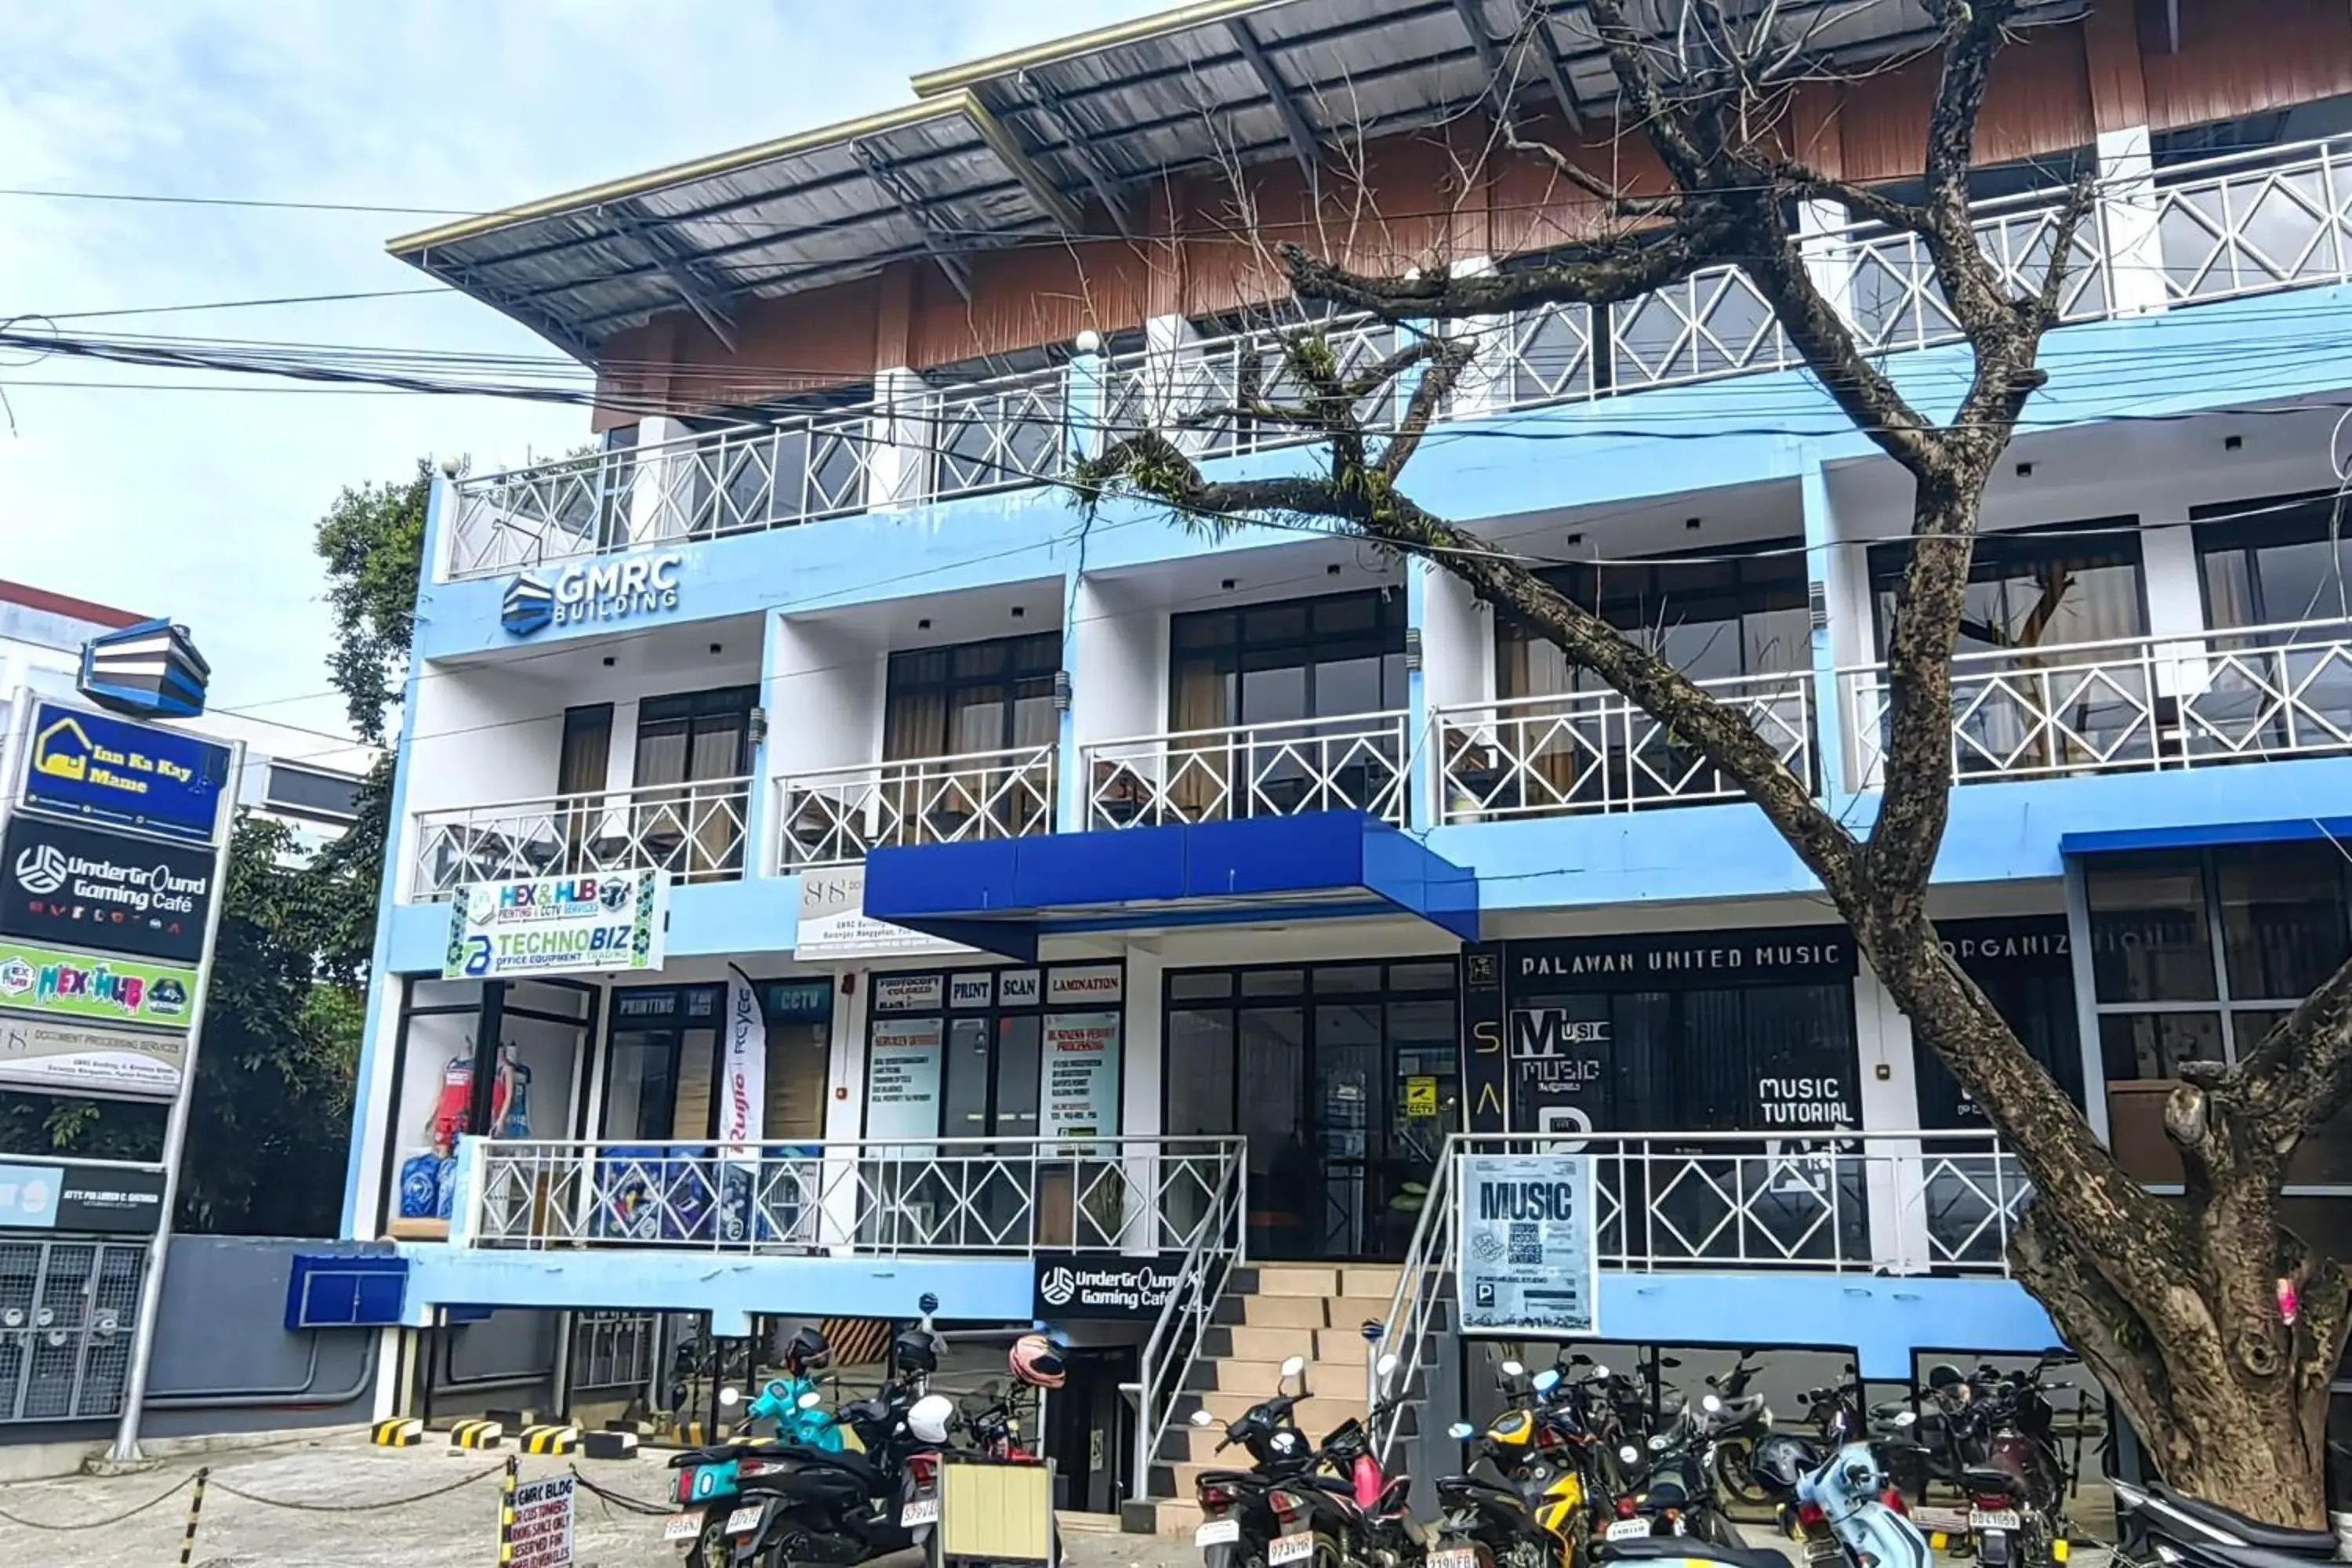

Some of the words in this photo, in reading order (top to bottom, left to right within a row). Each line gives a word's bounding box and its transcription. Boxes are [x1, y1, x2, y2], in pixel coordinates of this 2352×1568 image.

[556, 554, 681, 603] GMRC
[554, 589, 678, 622] BUILDING
[93, 744, 125, 766] Inn
[128, 752, 153, 772] Ka
[74, 880, 149, 910] Gaming
[152, 891, 192, 913] Café
[500, 884, 537, 908] HEX
[538, 883, 550, 905] &
[555, 878, 597, 903] HUB
[540, 904, 561, 917] CCTV
[498, 925, 632, 956] TECHNOBIZ
[496, 954, 528, 966] OFFICE
[530, 953, 582, 964] EQUIPMENT
[1522, 953, 1634, 976] PALAWAN
[1649, 948, 1742, 971] UNITED
[1755, 945, 1840, 967] MUSIC
[953, 982, 989, 1000] PRINT
[1004, 978, 1036, 996] SCAN
[1053, 977, 1118, 992] LAMINATION
[781, 990, 818, 1010] CCTV
[1523, 1061, 1600, 1082] MUSIC
[1759, 1078, 1838, 1098] MUSIC
[1761, 1102, 1855, 1123] TUTORIAL
[1480, 1181, 1572, 1221] MUSIC
[1076, 1266, 1182, 1291] UnderGrOun
[1081, 1290, 1138, 1309] Gaming
[546, 1479, 572, 1499] BLDG
[514, 1536, 548, 1558] ESERVED
